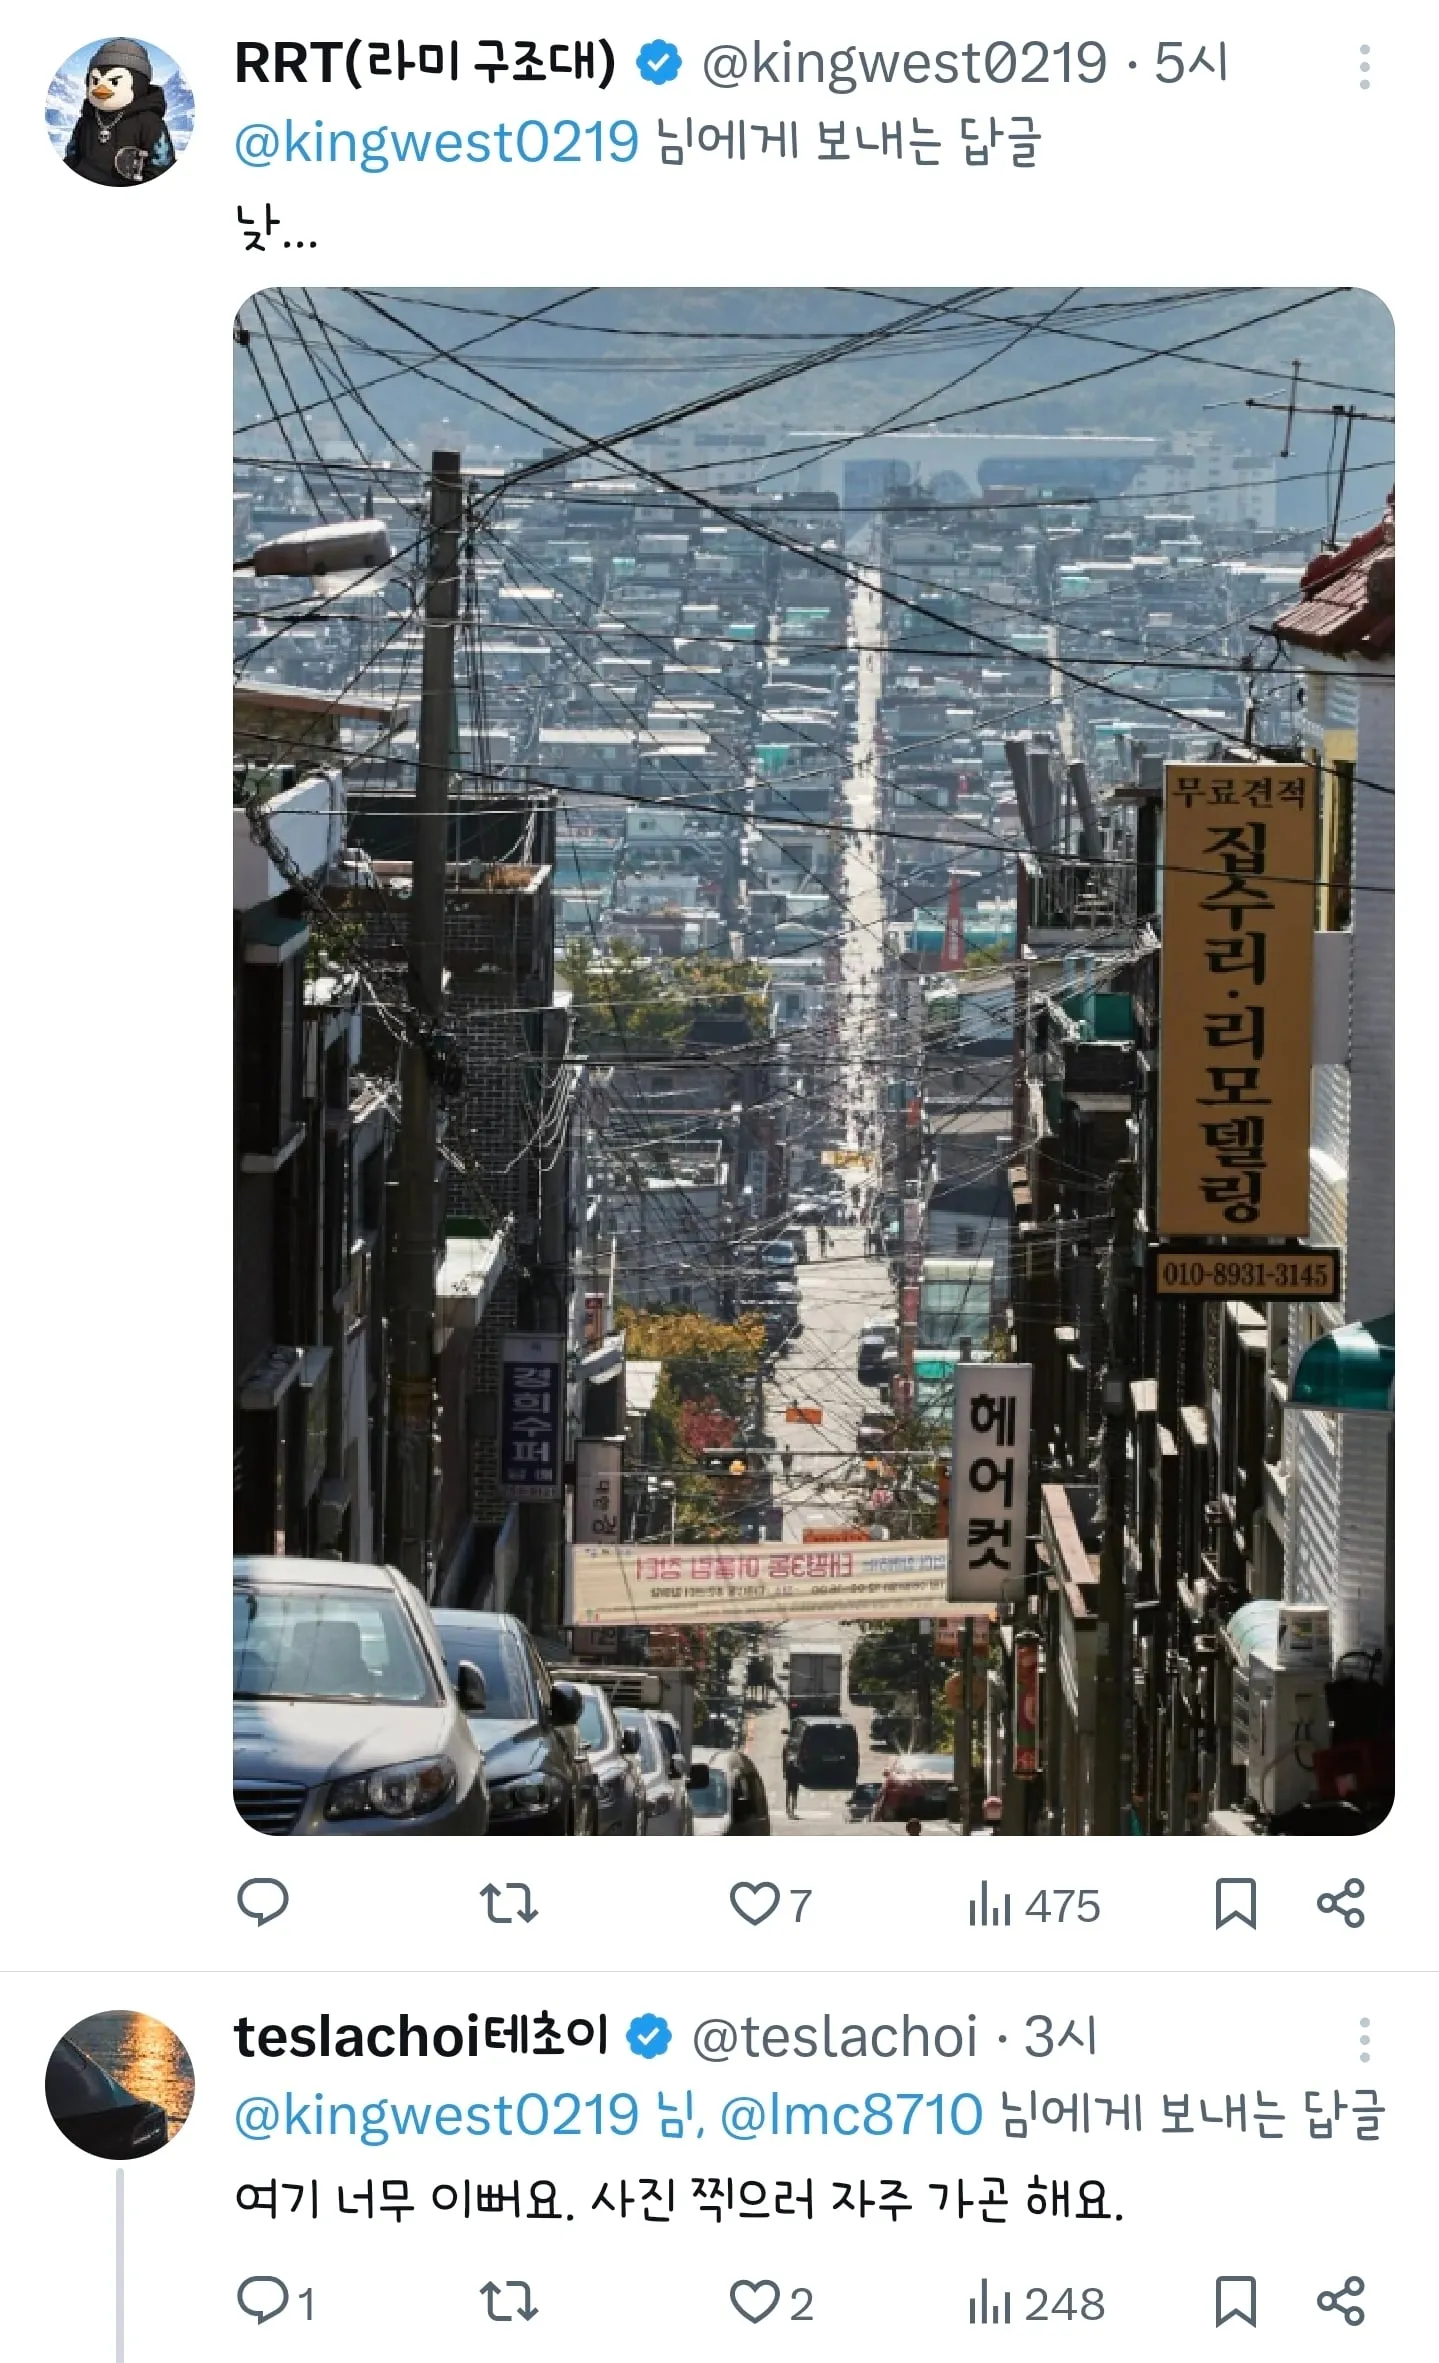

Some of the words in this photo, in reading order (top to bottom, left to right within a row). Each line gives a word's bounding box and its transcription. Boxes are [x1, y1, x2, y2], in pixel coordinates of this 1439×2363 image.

[237, 38, 458, 90] RRT(라미
[474, 38, 615, 90] 구조대)
[704, 40, 1107, 95] @kingwest0219
[1156, 41, 1226, 84] 5시
[236, 118, 639, 173] @kingwest0219
[659, 116, 798, 166] 님에게
[818, 116, 942, 166] 보내는
[961, 116, 1042, 168] 답글
[237, 202, 317, 252] 낮...
[1172, 777, 1307, 810] 무료견적
[1195, 821, 1276, 1224] 집수리·리모델링
[1162, 1260, 1329, 1288] 010-8931-3145
[968, 1394, 1017, 1570] 헤어컷
[791, 1889, 813, 1923] 7
[1026, 1889, 1101, 1923] 475
[234, 2010, 607, 2058] teslachoi테초이
[694, 2013, 977, 2063] @teslachoi
[1026, 2014, 1095, 2058] 3시
[236, 2091, 639, 2146] @kingwest0219
[658, 2089, 704, 2141] 님,
[722, 2091, 983, 2141] @lmc8710
[1002, 2089, 1142, 2139] 님에게
[1162, 2089, 1286, 2139] 보내는
[1305, 2089, 1386, 2141] 답글
[237, 2178, 318, 2220] 여기
[338, 2178, 415, 2224] 너무
[432, 2178, 574, 2222] 이뻐요.
[592, 2177, 674, 2223] 사진
[692, 2176, 813, 2224] 찍으러
[833, 2179, 913, 2223] 자주
[929, 2176, 1009, 2224] 가곤
[1028, 2174, 1123, 2222] 해요.
[298, 2287, 312, 2321] 1
[791, 2287, 814, 2321] 2
[1026, 2287, 1105, 2321] 248
